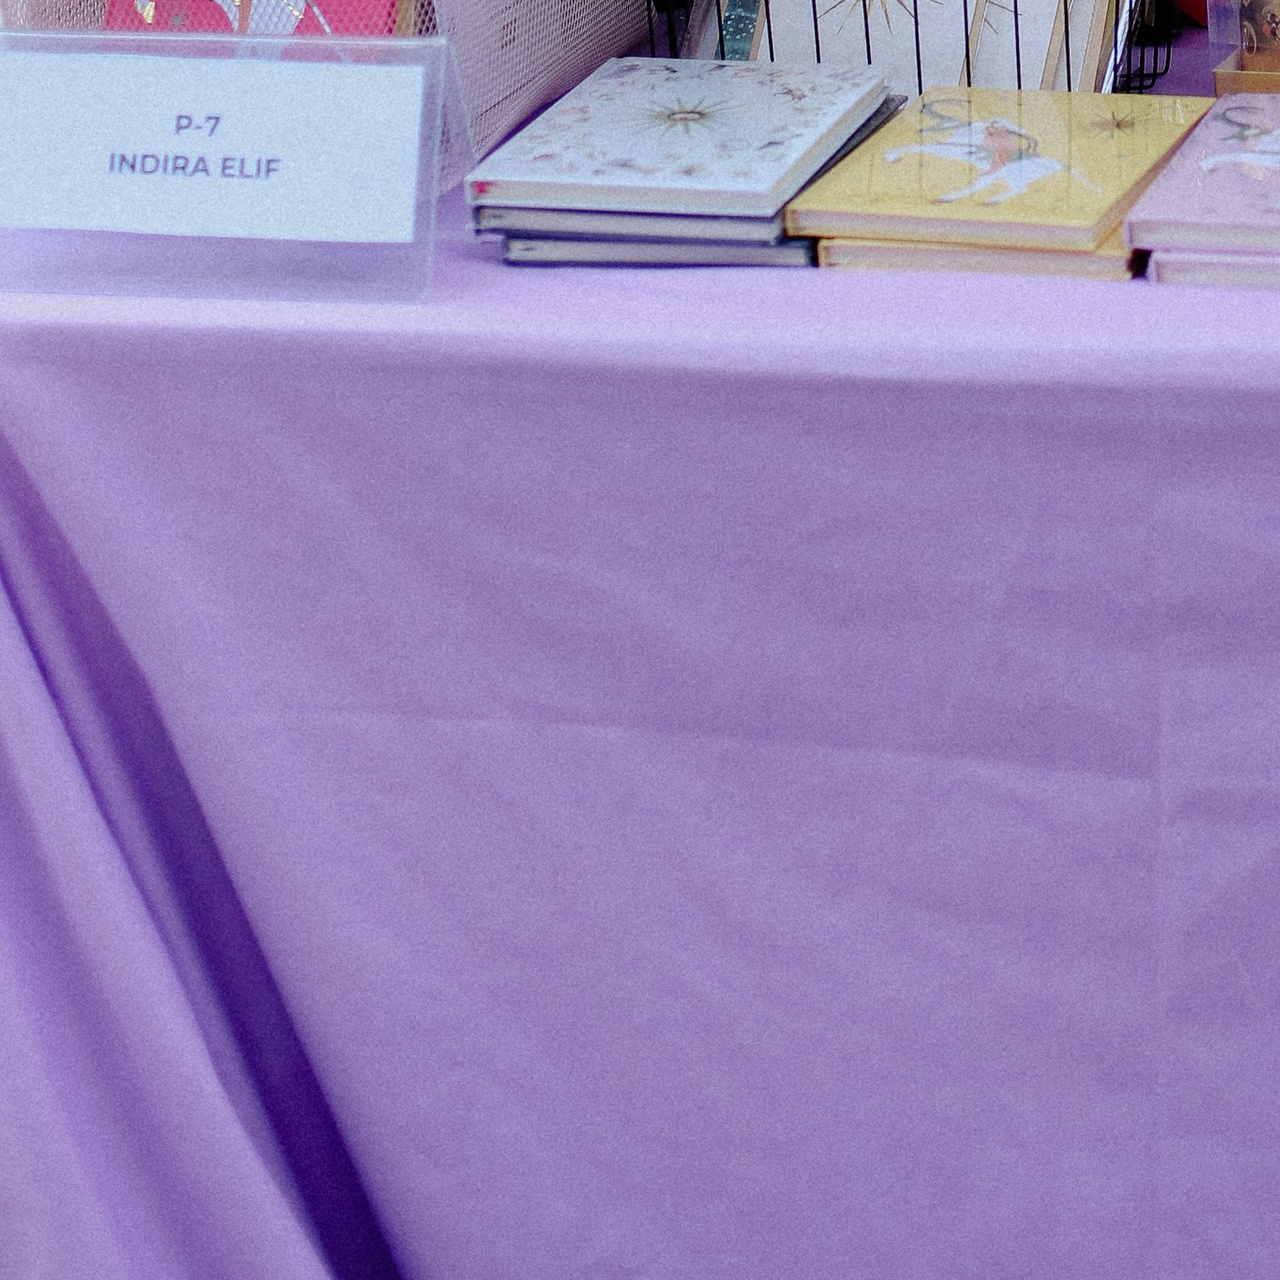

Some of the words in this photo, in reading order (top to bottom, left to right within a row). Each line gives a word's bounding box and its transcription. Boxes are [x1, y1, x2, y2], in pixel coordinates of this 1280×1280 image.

[174, 114, 221, 138] P-7
[109, 152, 210, 178] INDIRA
[221, 156, 283, 180] ELIF
